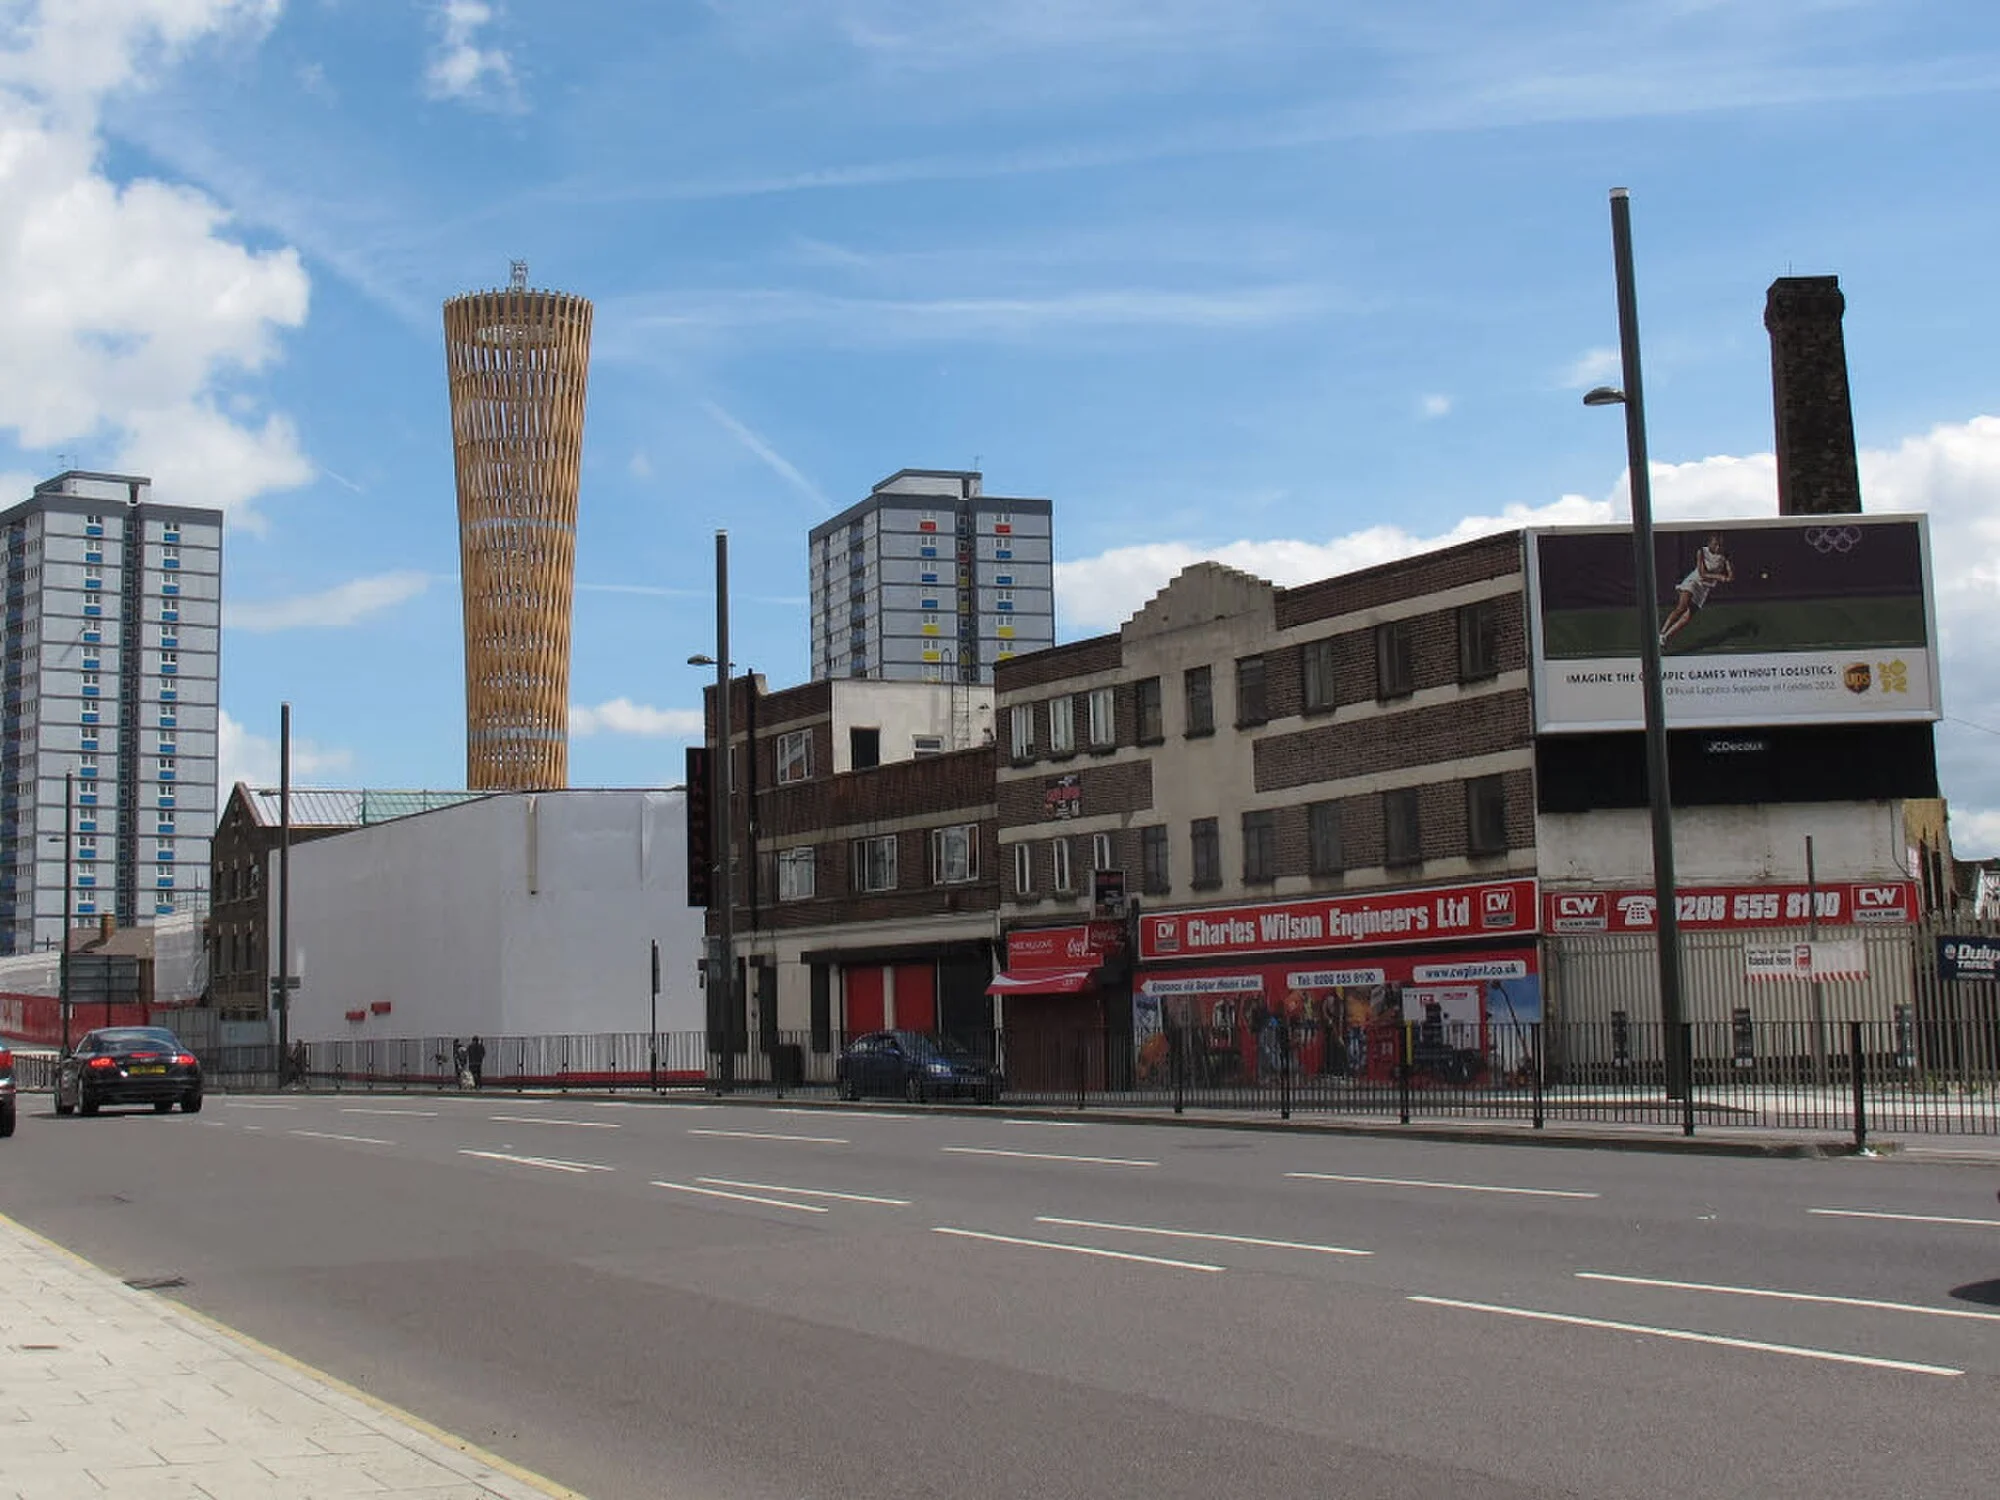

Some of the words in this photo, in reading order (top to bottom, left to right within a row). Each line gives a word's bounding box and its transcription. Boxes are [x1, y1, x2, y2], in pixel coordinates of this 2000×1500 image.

[1566, 672, 1613, 683] IMAGINE
[1617, 672, 1636, 682] THE
[1688, 669, 1726, 680] GAMES
[1729, 667, 1777, 678] WITHOUT
[1486, 893, 1510, 912] CW
[1560, 896, 1598, 915] CW
[1734, 894, 1779, 920] 555
[1786, 892, 1840, 918] 8100
[1858, 888, 1897, 905] CW
[1187, 917, 1256, 946] Charles
[1260, 913, 1322, 941] Wilson
[1329, 906, 1429, 940] Engineers
[1436, 896, 1470, 928] Ltd
